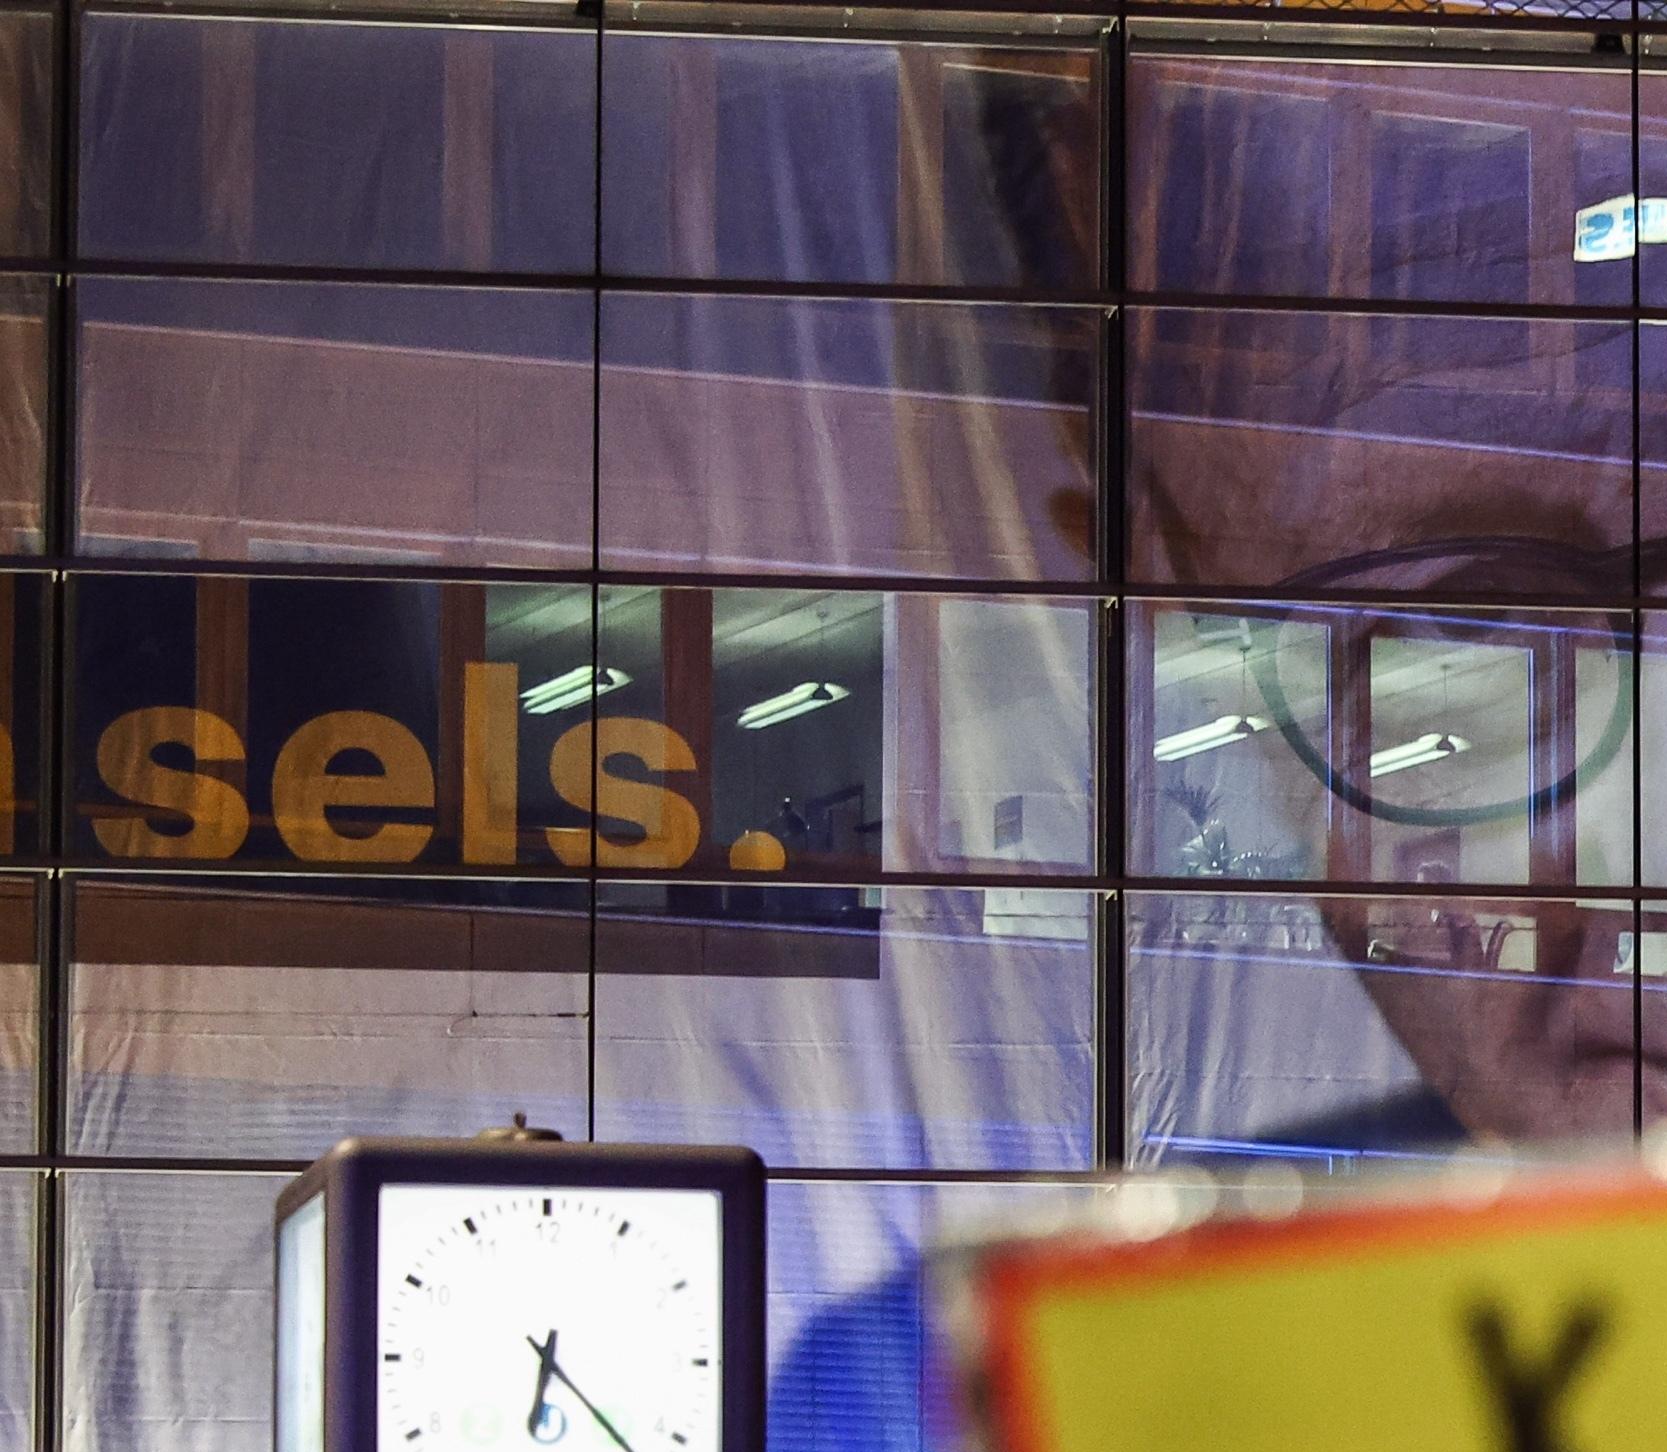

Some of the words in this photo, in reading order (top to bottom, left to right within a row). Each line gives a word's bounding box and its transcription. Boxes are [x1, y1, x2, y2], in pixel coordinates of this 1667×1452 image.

[0, 662, 787, 872] sels.
[535, 1222, 560, 1244] 12
[426, 1285, 450, 1306] 10
[412, 1347, 425, 1369] 9
